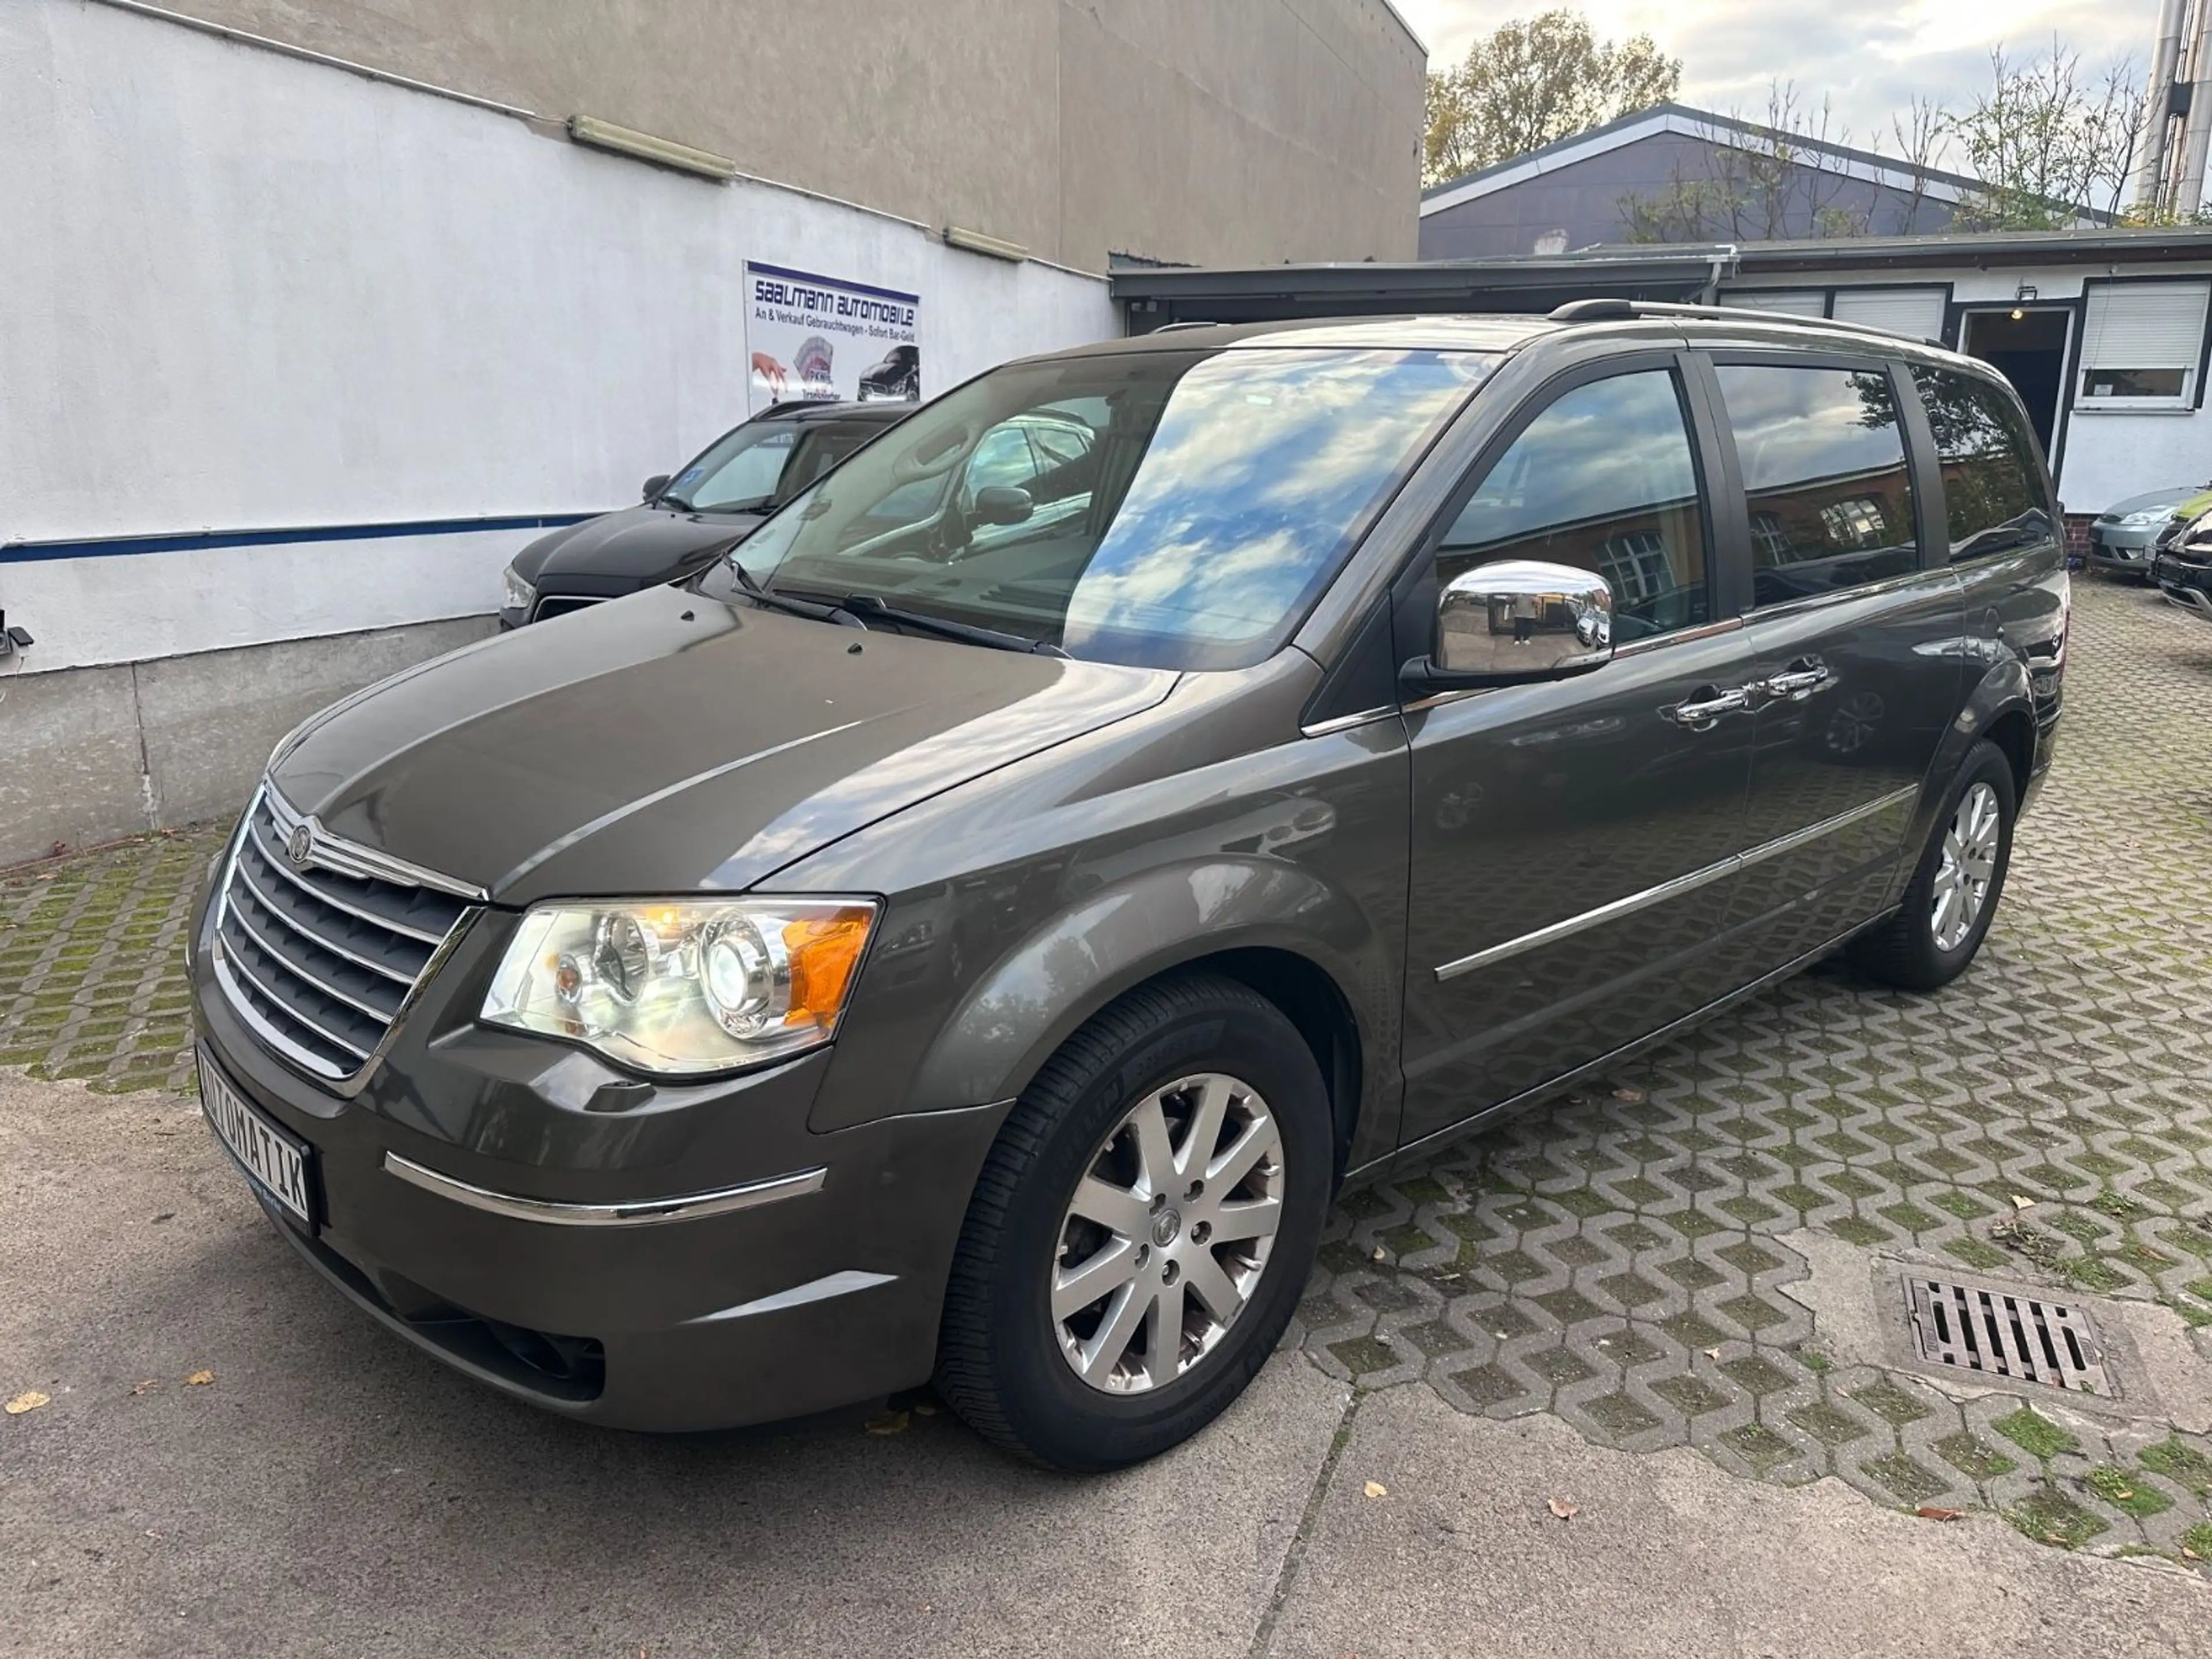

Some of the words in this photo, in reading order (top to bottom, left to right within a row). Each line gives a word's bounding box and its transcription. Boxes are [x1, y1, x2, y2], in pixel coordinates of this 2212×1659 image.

[755, 307, 766, 319] An
[768, 308, 774, 321] &
[775, 310, 805, 326] Verkauf
[806, 314, 863, 337] Gebrauchtwagen
[868, 324, 888, 339] Sofort
